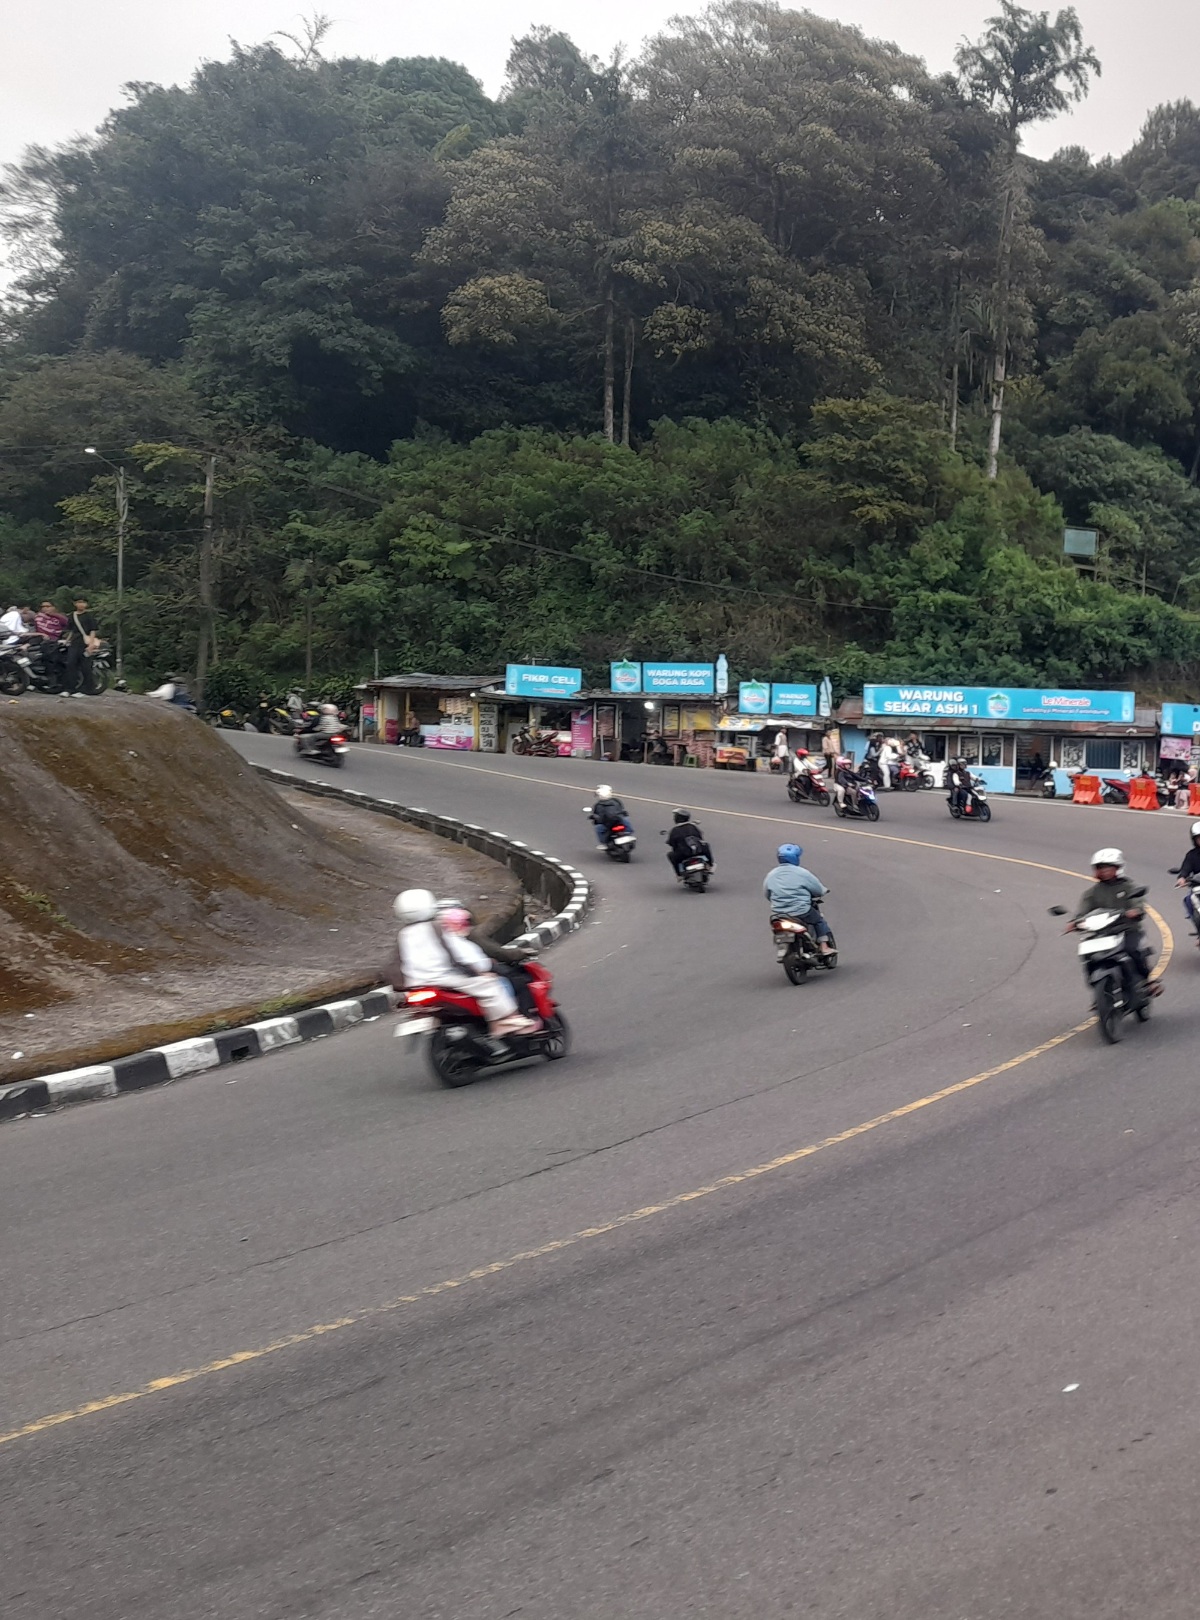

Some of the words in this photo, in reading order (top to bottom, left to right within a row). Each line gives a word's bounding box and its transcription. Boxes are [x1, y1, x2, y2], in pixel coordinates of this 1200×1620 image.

[522, 673, 549, 683] FIKRI
[551, 675, 577, 685] CELL
[646, 669, 688, 677] WARUNG
[688, 669, 711, 678] KOPI
[652, 677, 679, 686] BOGA
[680, 677, 705, 686] RASA
[898, 689, 965, 702] WARUNG
[883, 701, 932, 714] SEKAR
[935, 703, 970, 715] ASIH
[972, 704, 979, 715] 1
